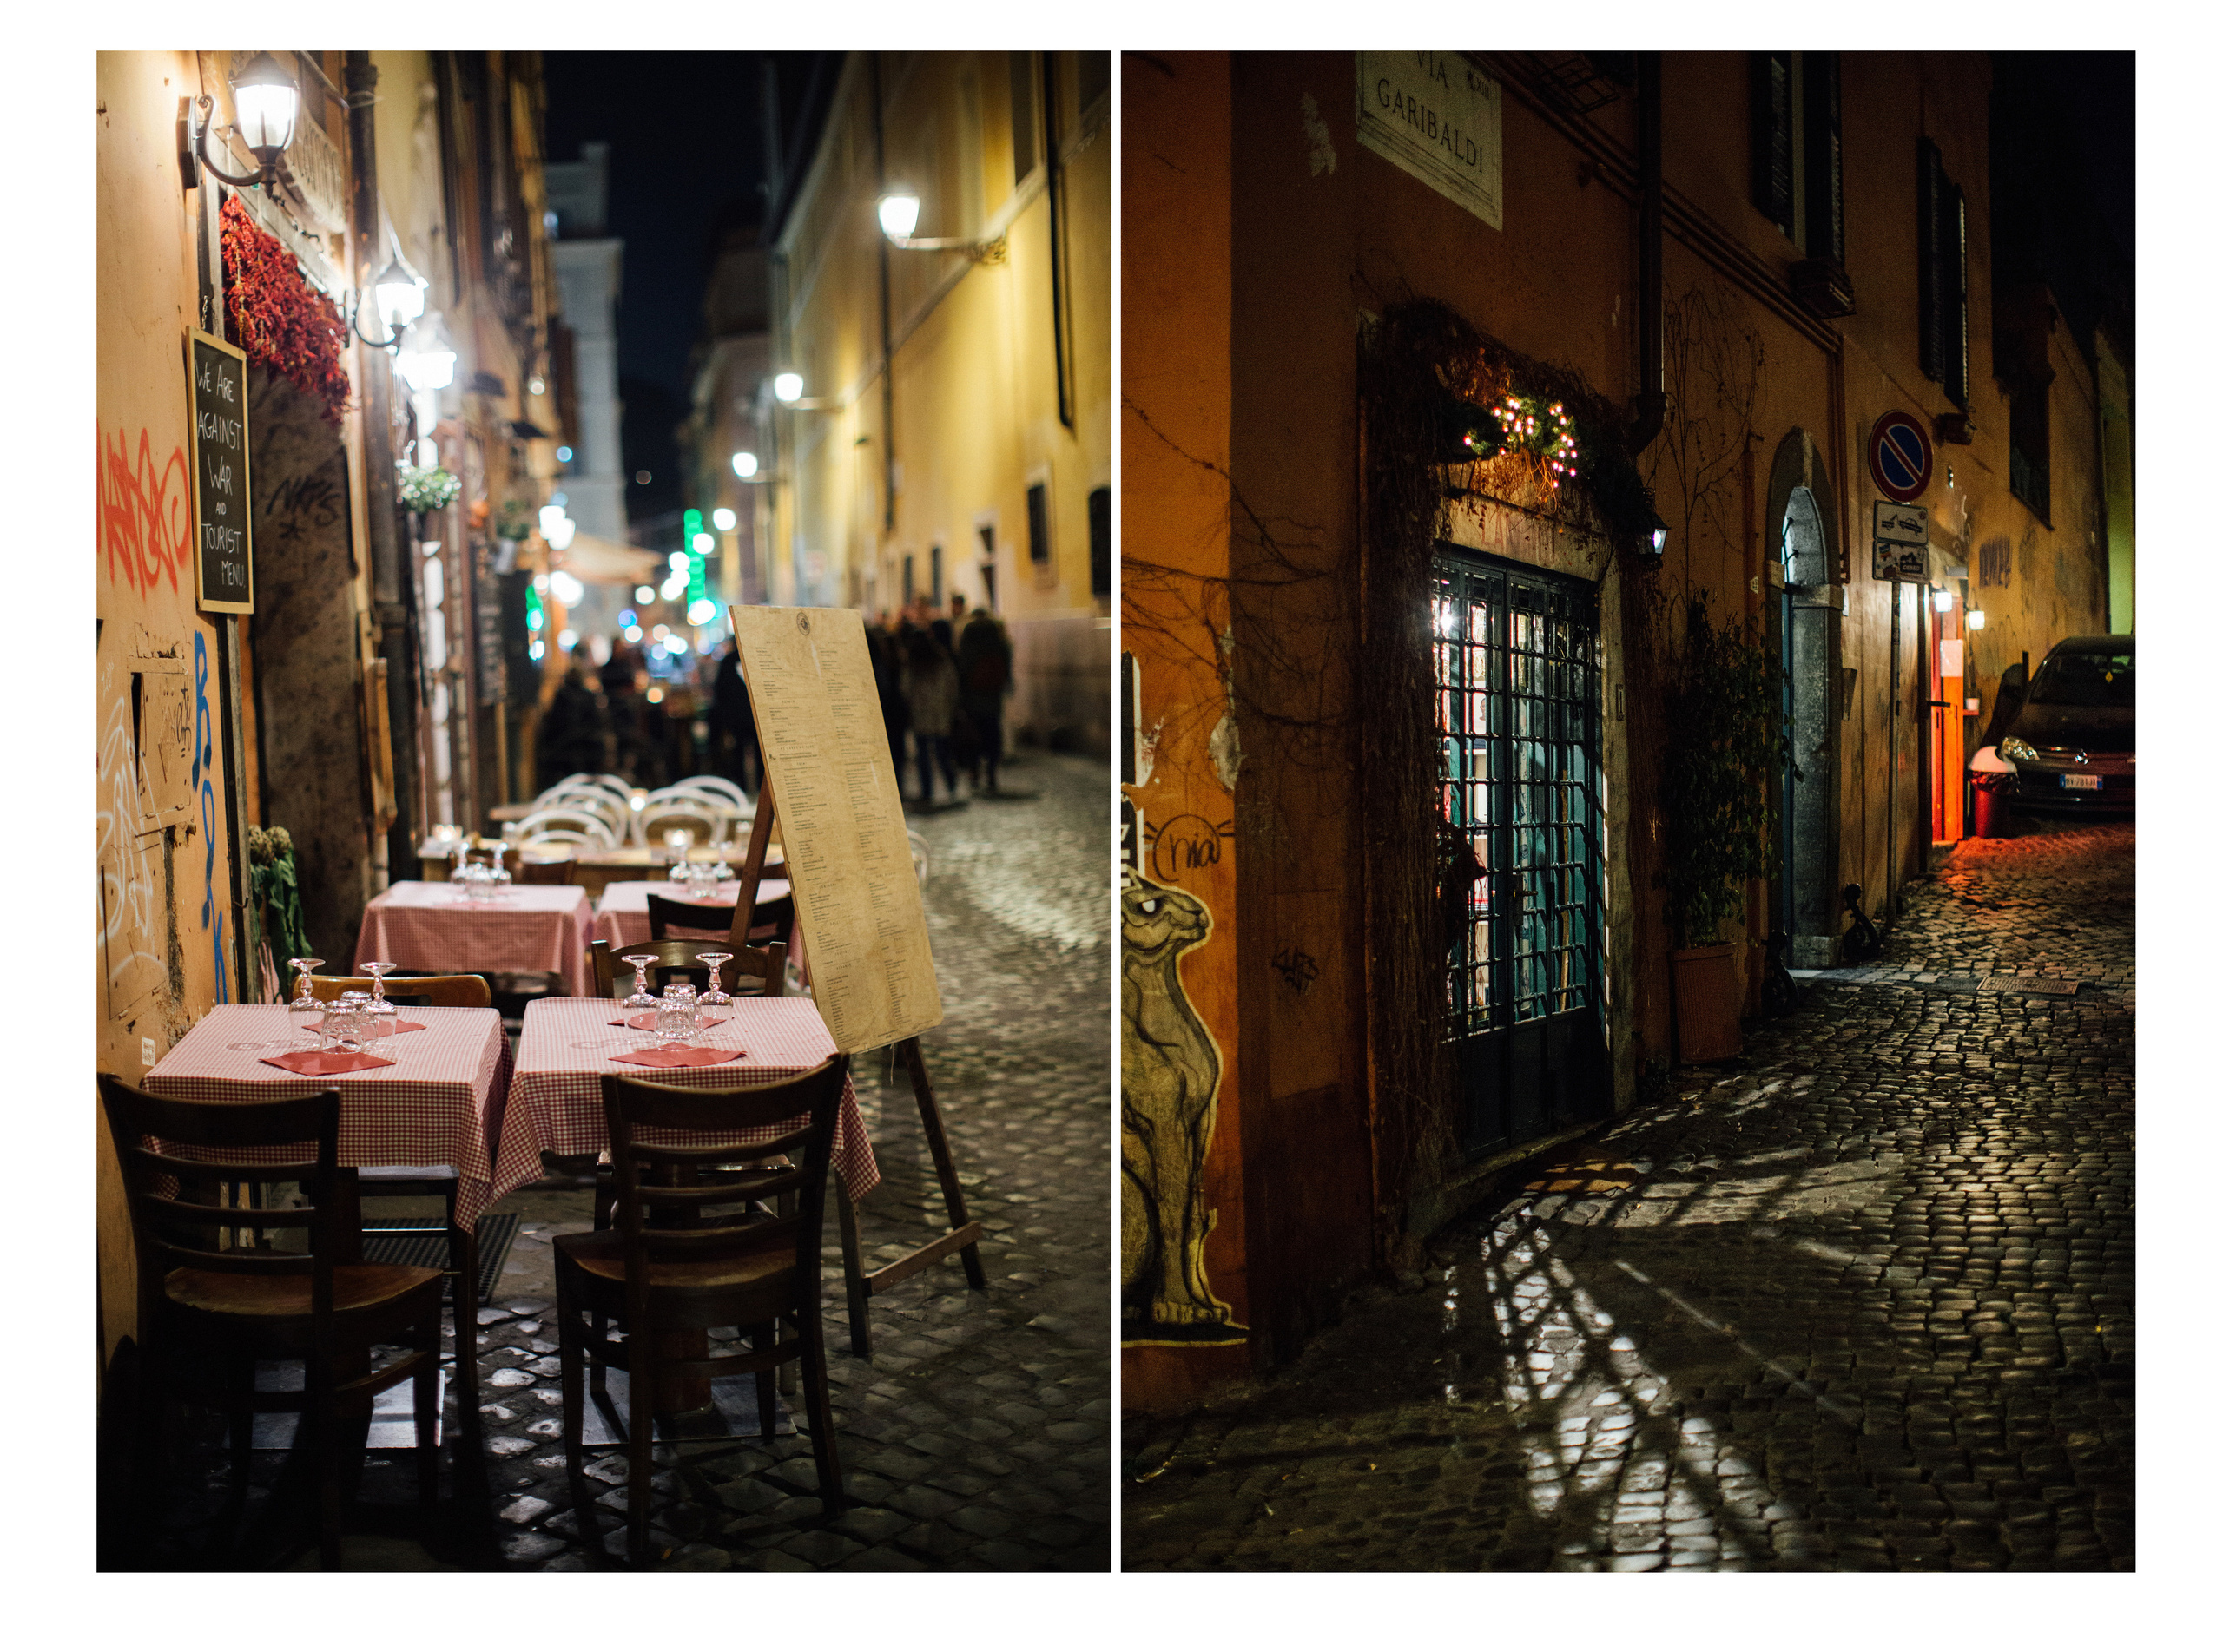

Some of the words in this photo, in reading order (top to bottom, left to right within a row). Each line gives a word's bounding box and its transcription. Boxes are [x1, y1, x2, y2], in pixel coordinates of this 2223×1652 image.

[1416, 51, 1449, 89] VIA
[1377, 77, 1483, 174] GARIBALDI
[195, 359, 212, 392] WE
[215, 364, 234, 403] ARE
[197, 409, 242, 451] AGAINST
[207, 454, 233, 497] WAR
[215, 501, 227, 516] AND
[201, 523, 242, 556] TOURIST
